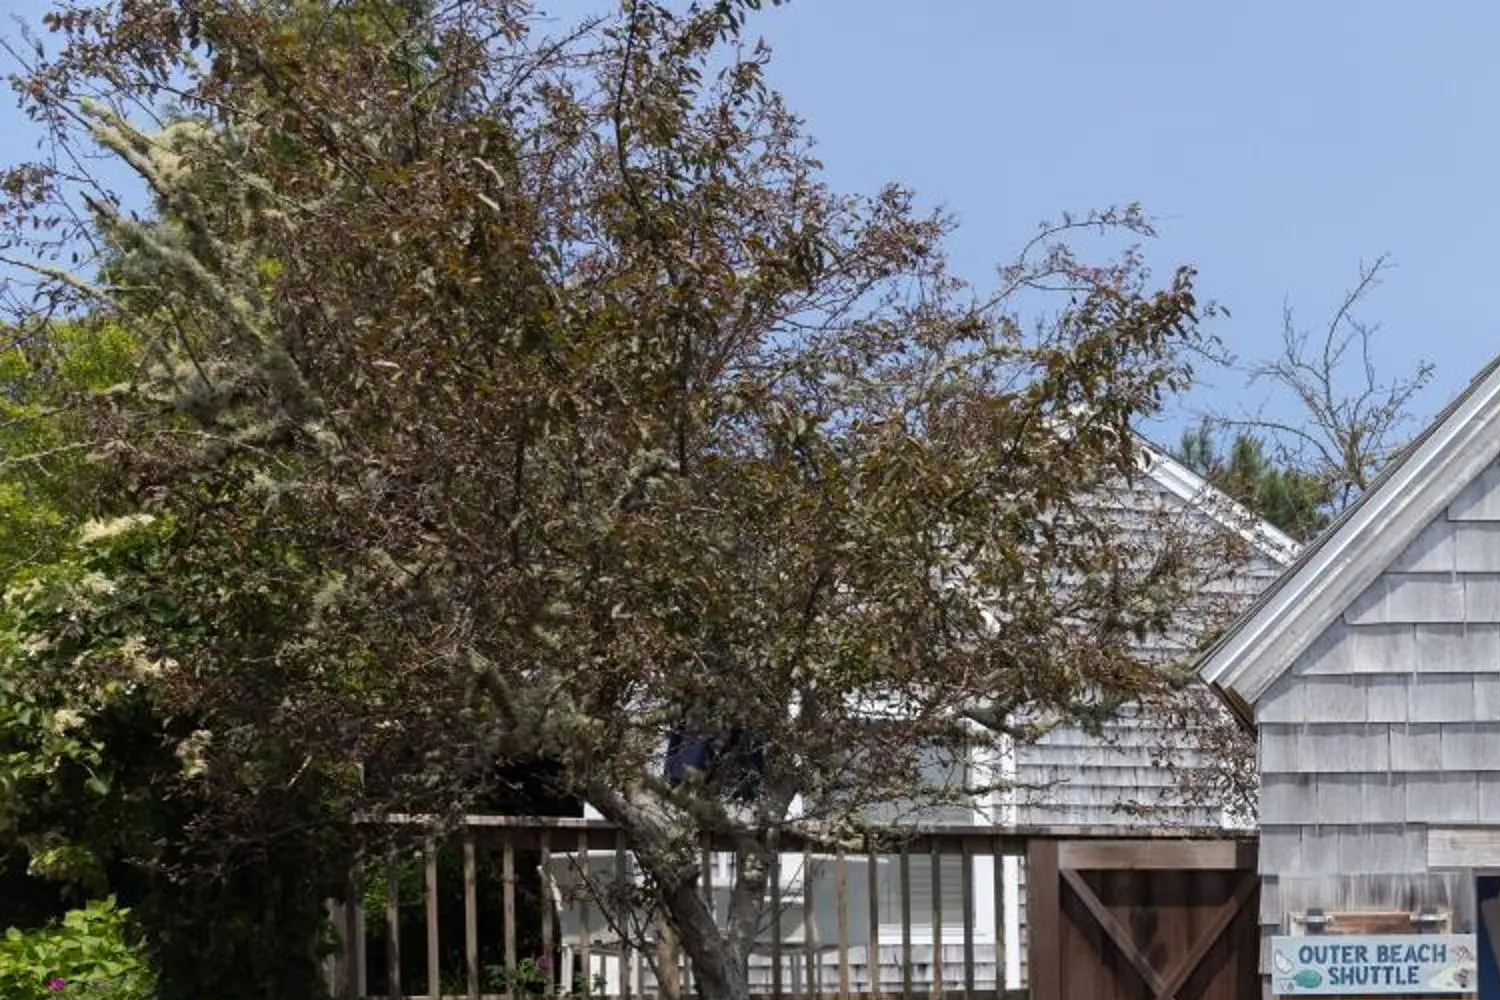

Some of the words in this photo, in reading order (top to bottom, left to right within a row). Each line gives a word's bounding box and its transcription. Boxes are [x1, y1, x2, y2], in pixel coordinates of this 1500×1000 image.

[1299, 945, 1368, 964] OUTER
[1377, 944, 1447, 963] BEACH
[1328, 966, 1420, 985] SHUTTLE
